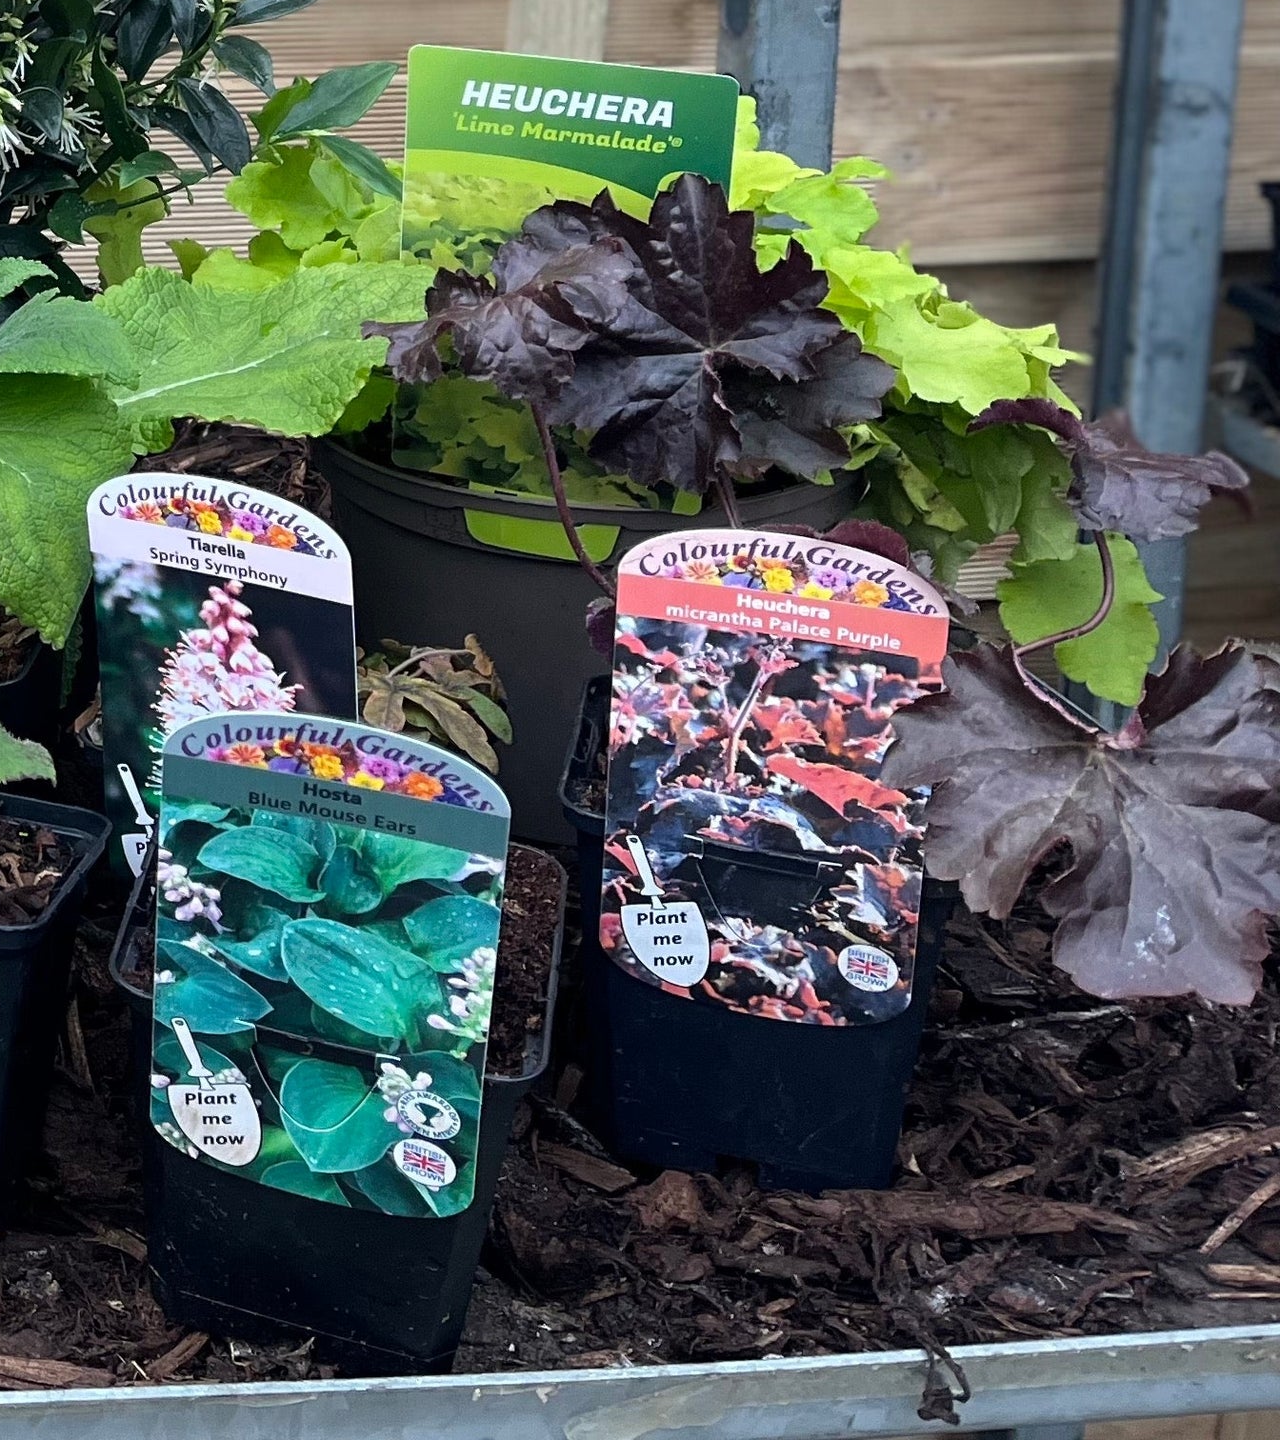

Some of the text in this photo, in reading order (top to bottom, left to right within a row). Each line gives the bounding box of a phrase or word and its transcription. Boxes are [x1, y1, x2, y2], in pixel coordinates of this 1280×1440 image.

[461, 80, 675, 128] HEUCHERA
[98, 481, 338, 560] Colourful Gardens
[187, 536, 246, 560] Tiarella
[150, 547, 288, 588] Spring Symphony
[639, 537, 938, 616] Colourful Gardens
[737, 593, 831, 620] Heuchera
[666, 603, 901, 651] micrantha Palace Purple
[180, 722, 495, 812] Colourful Gardens
[303, 782, 362, 805] Hosta
[248, 791, 417, 835] Blue Mouse Ears
[637, 912, 688, 926] Plant
[653, 933, 682, 945] me
[653, 954, 694, 966] now
[847, 948, 890, 965] BRITISH
[845, 971, 888, 988] GROWN
[185, 1092, 237, 1106] Plant
[416, 1091, 452, 1111] AWARD
[202, 1114, 232, 1126] me
[202, 1133, 244, 1146] now
[403, 1142, 447, 1162] BRITISH
[402, 1164, 446, 1184] GROWN
